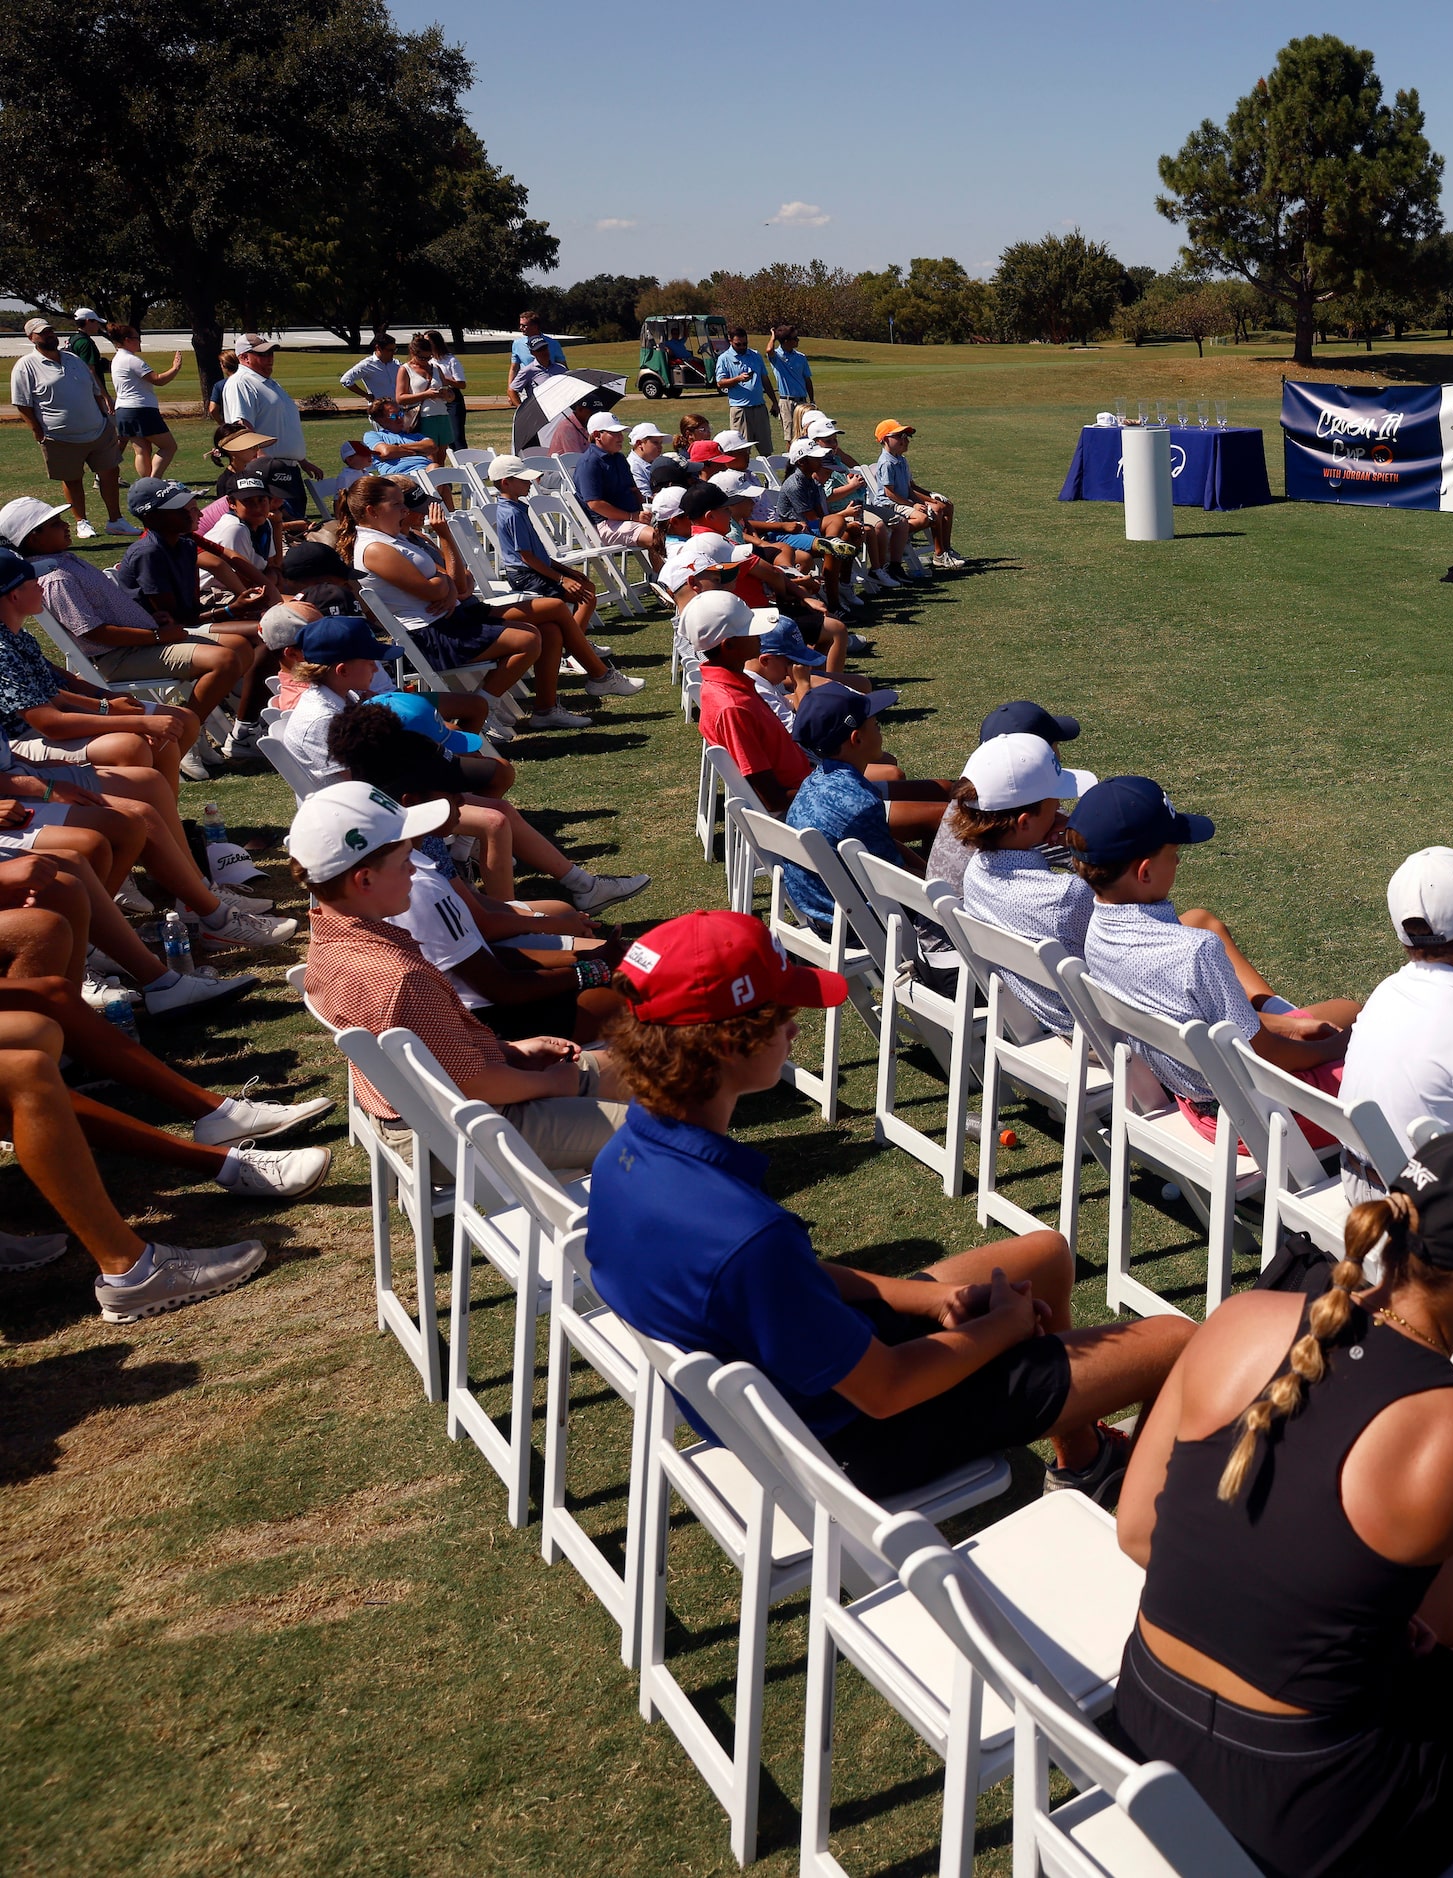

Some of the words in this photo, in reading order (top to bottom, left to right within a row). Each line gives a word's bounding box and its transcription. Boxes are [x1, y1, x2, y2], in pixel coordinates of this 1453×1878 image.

[239, 479, 263, 488] PING
[1323, 468, 1342, 478] WITH
[1342, 469, 1371, 481] JORDAN
[1371, 472, 1399, 483] SPIETH
[731, 974, 755, 1006] FJ
[1400, 1158, 1439, 1191] PXG
